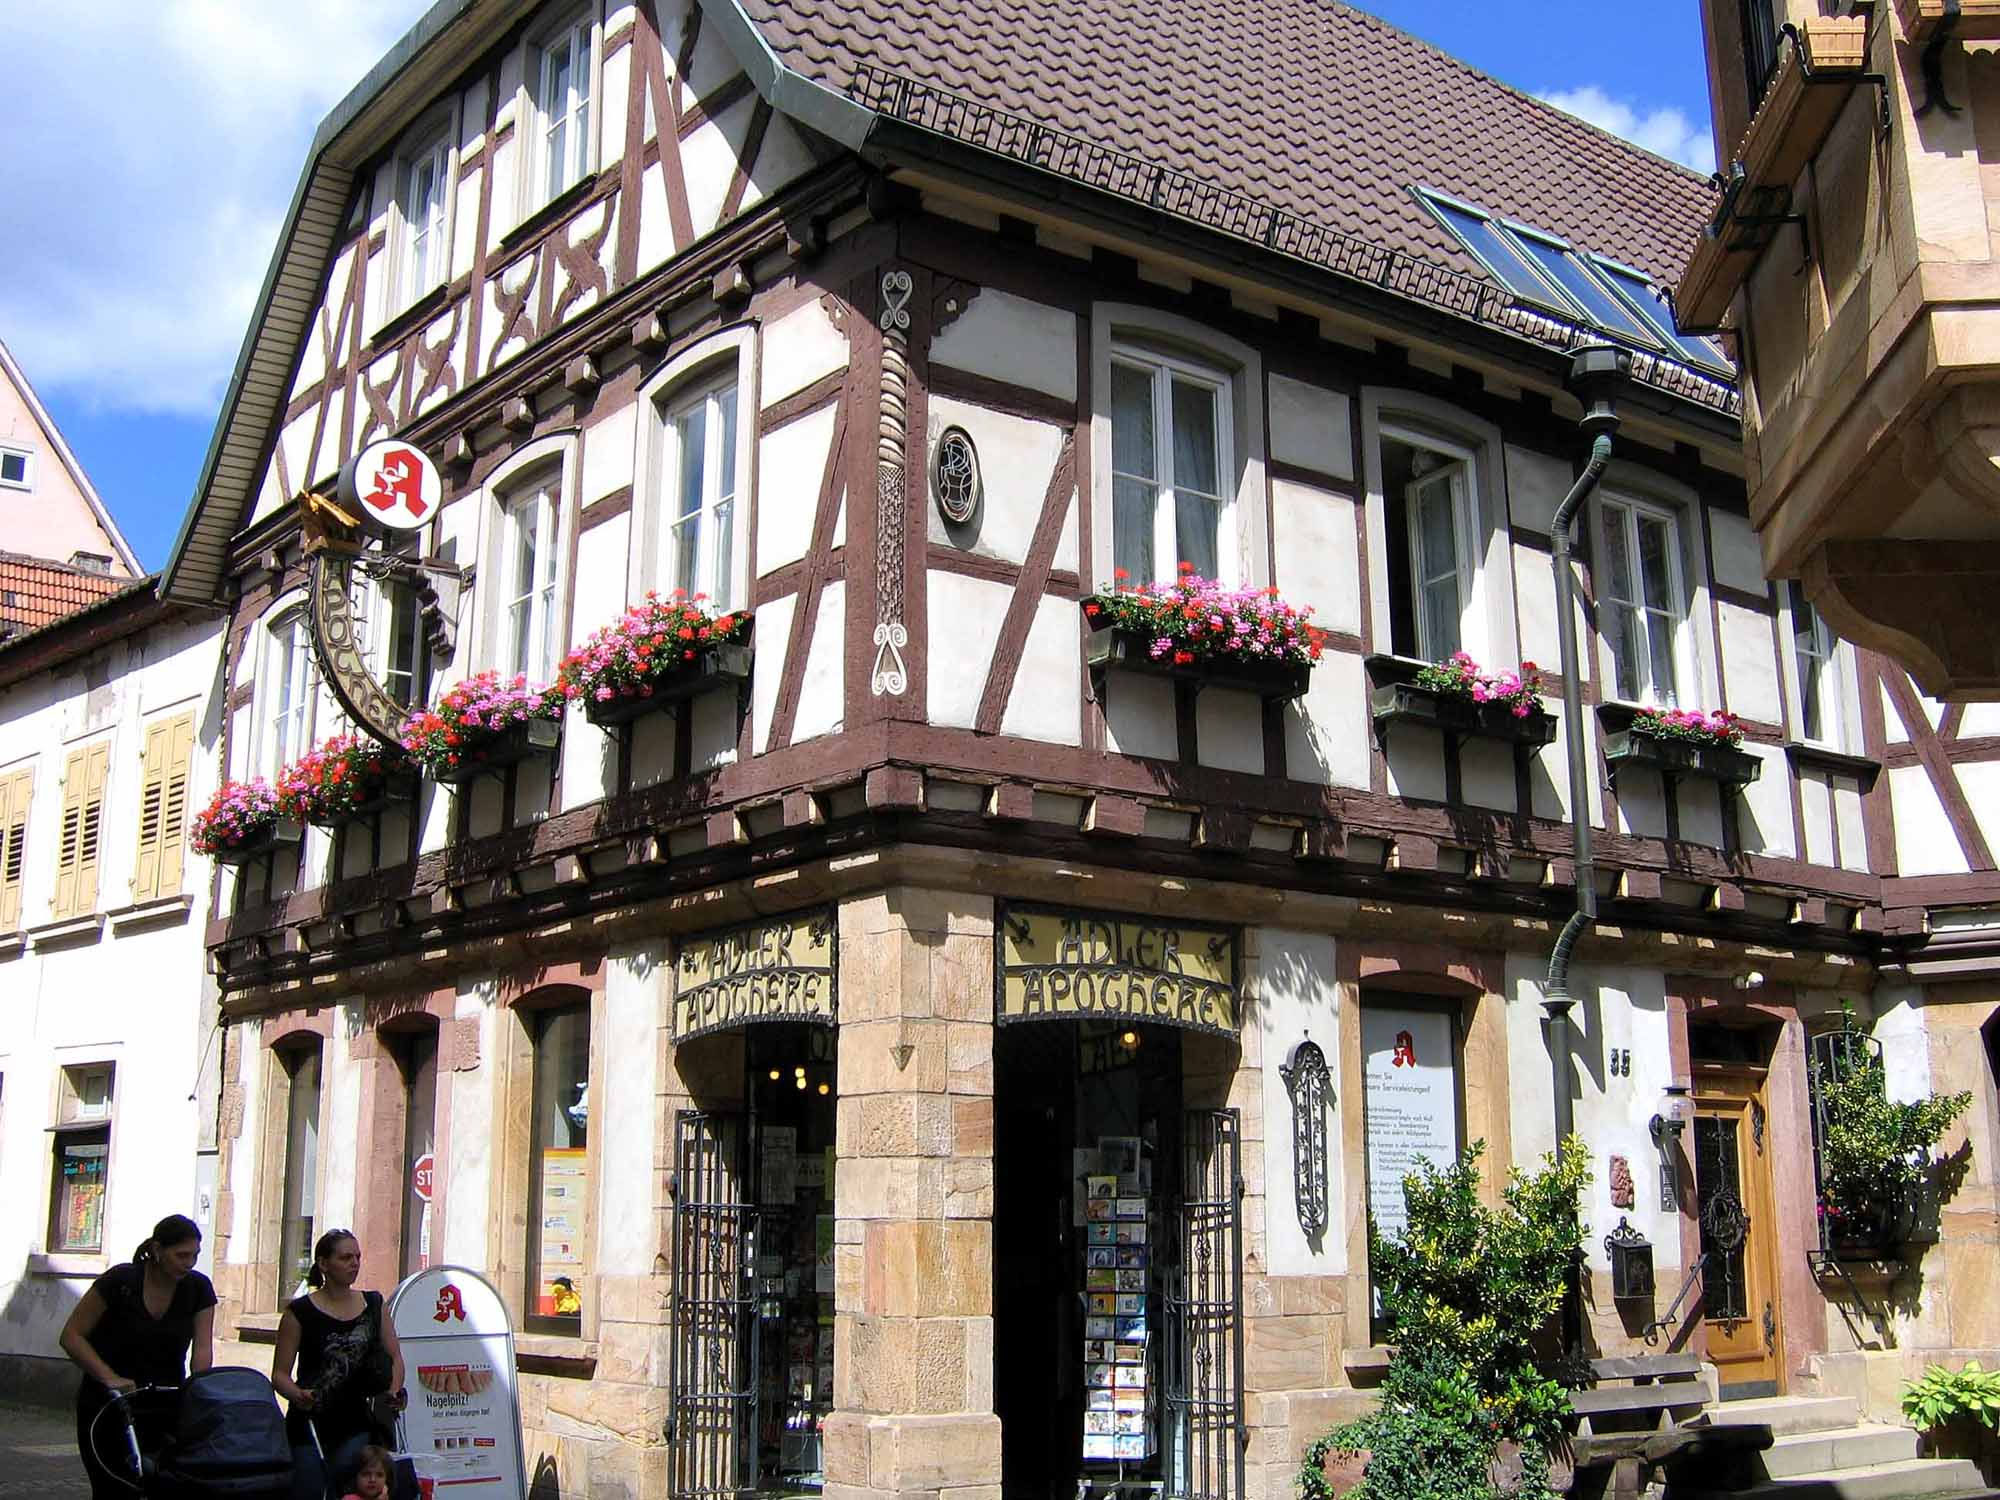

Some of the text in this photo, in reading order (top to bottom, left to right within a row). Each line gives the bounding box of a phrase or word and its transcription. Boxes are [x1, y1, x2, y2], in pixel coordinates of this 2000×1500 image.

[710, 923, 794, 980] ADLER
[1060, 919, 1184, 975] ADLER
[416, 1169, 432, 1186] ST
